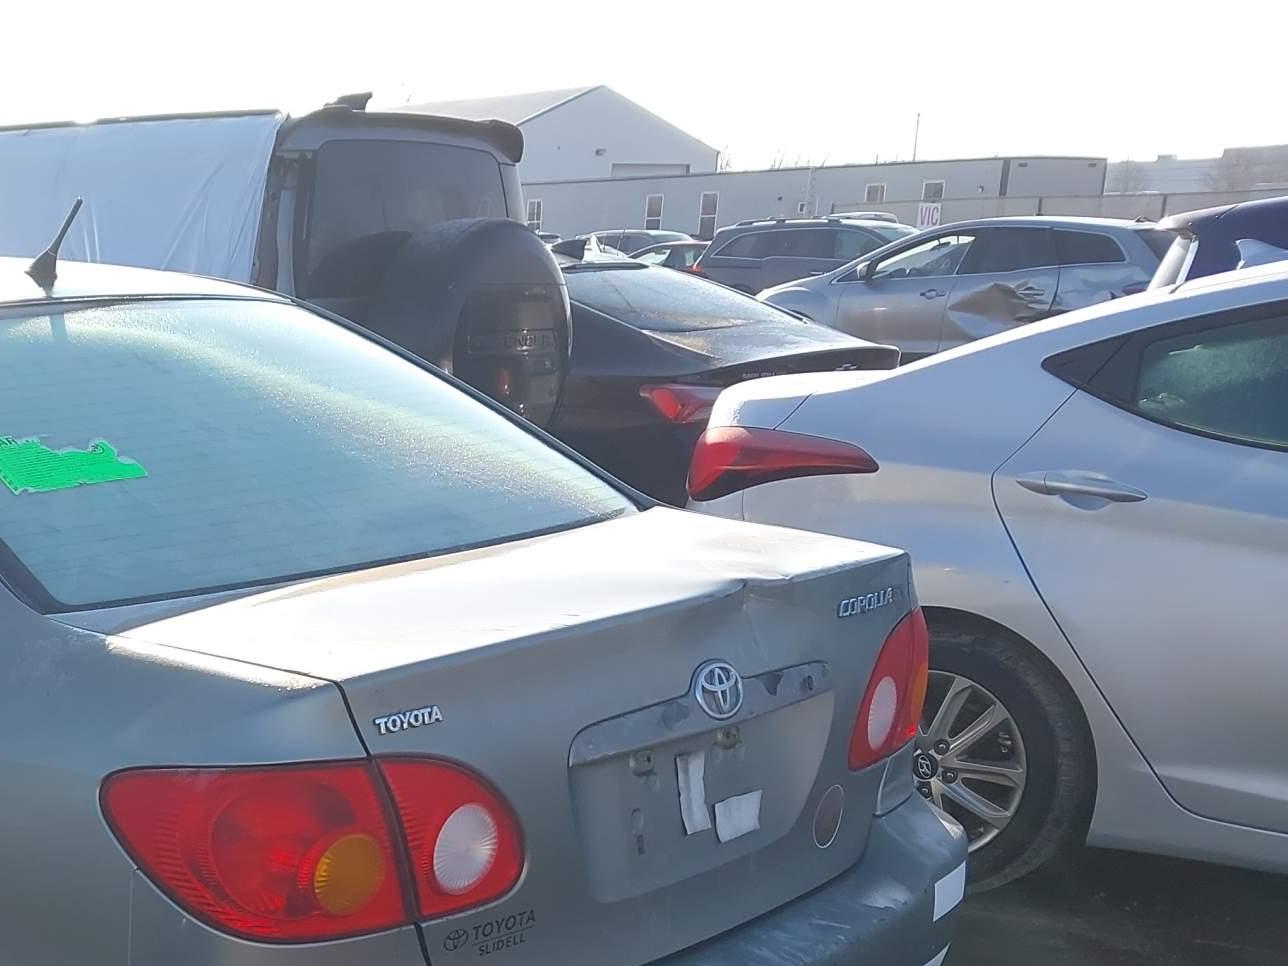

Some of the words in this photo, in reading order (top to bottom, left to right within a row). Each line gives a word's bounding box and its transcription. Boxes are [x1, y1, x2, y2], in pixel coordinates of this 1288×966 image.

[920, 206, 940, 226] VIC
[838, 586, 894, 617] COROLLA
[374, 705, 444, 735] TOYOTA
[472, 908, 537, 941] TOYOTA
[478, 932, 527, 956] SLIDELL
